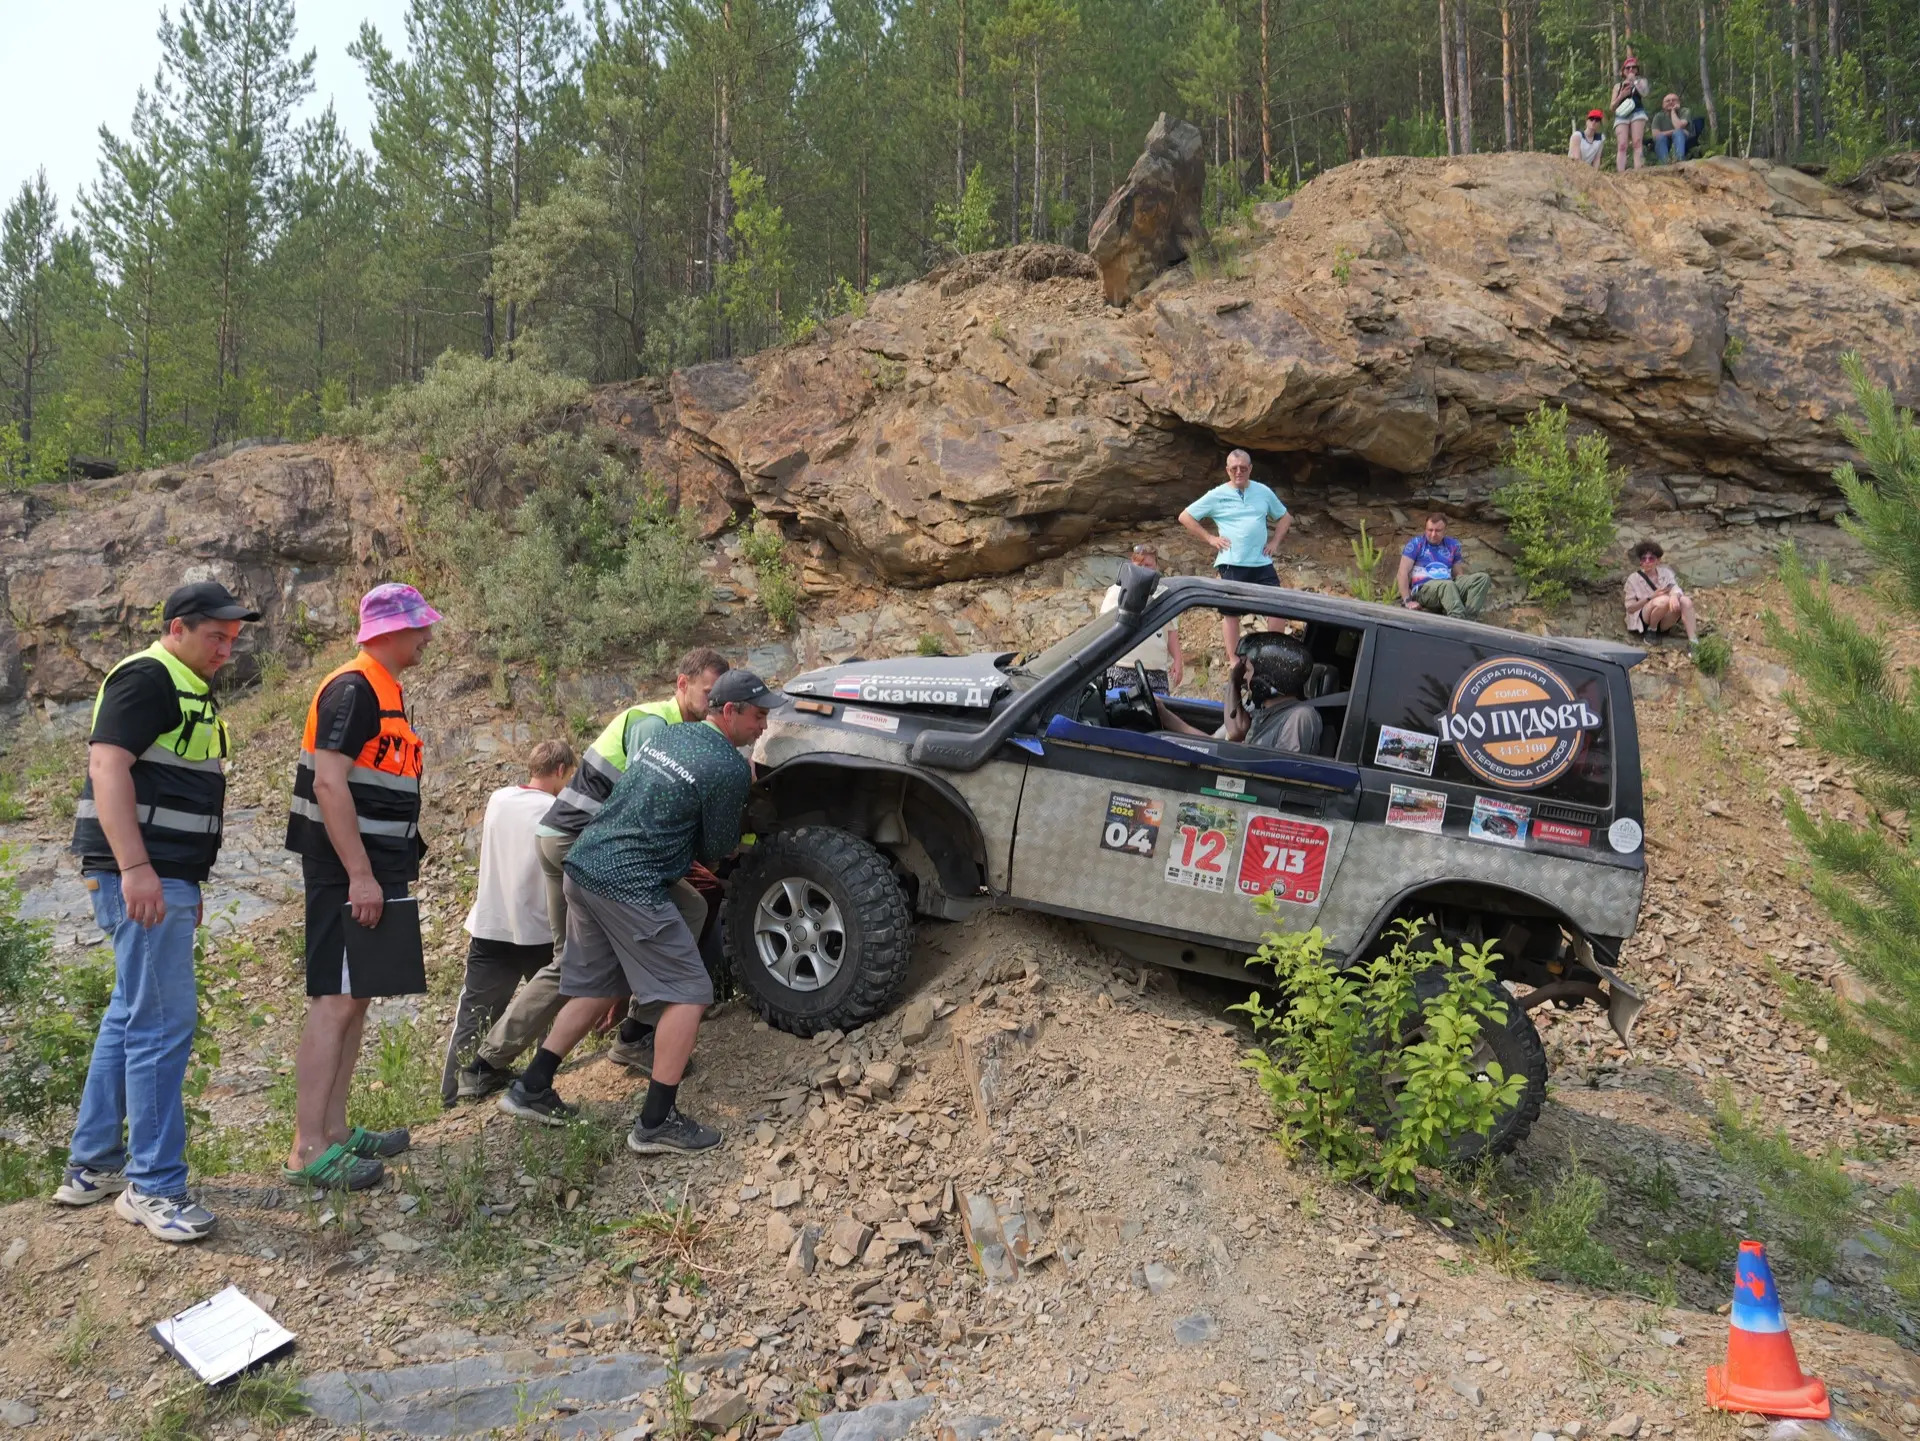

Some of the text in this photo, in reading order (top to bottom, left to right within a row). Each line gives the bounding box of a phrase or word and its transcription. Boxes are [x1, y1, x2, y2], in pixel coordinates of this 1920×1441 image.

[1470, 667, 1547, 696] ОПЕРАТИВНАЯ
[1493, 687, 1529, 699] ТОМСК
[862, 685, 989, 707] Скачков Д.
[1437, 710, 1486, 742] 100
[1473, 739, 1568, 777] ПЕРЕВОЗКА ГРУЗОВ
[1218, 790, 1240, 799] СПОРТ
[1110, 805, 1135, 817] 2026
[1104, 822, 1152, 854] 04
[1250, 828, 1295, 843] ЧЕМПИОНАТ
[1548, 825, 1583, 838] ЛУКОЙЛ
[1179, 825, 1228, 873] 12
[1262, 845, 1307, 874] 713
